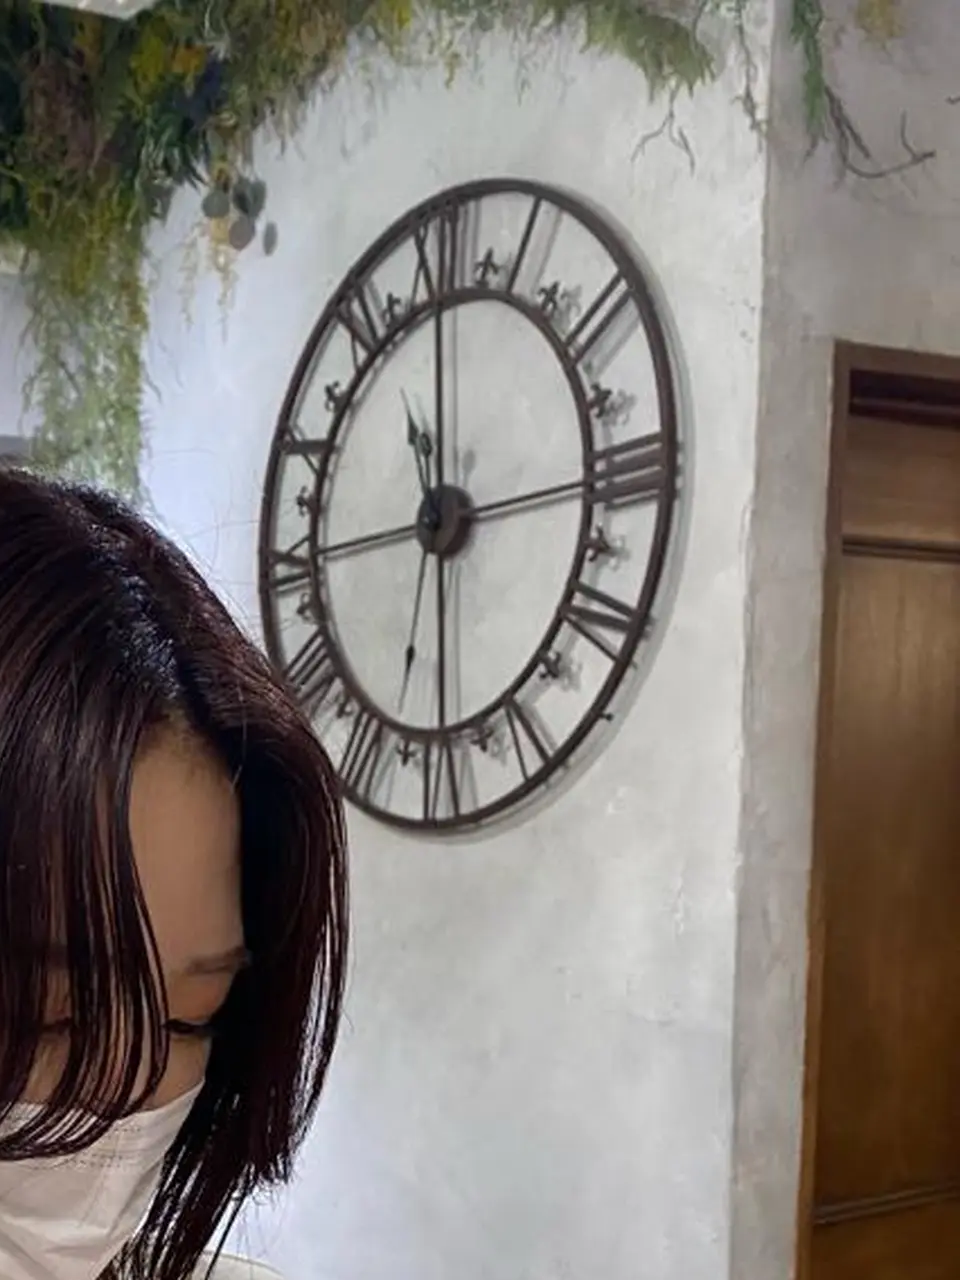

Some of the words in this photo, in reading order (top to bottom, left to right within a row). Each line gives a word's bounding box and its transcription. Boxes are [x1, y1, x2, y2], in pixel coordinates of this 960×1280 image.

[408, 195, 460, 306] XII
[562, 268, 634, 362] II
[588, 430, 662, 503] III
[502, 696, 555, 780] V
